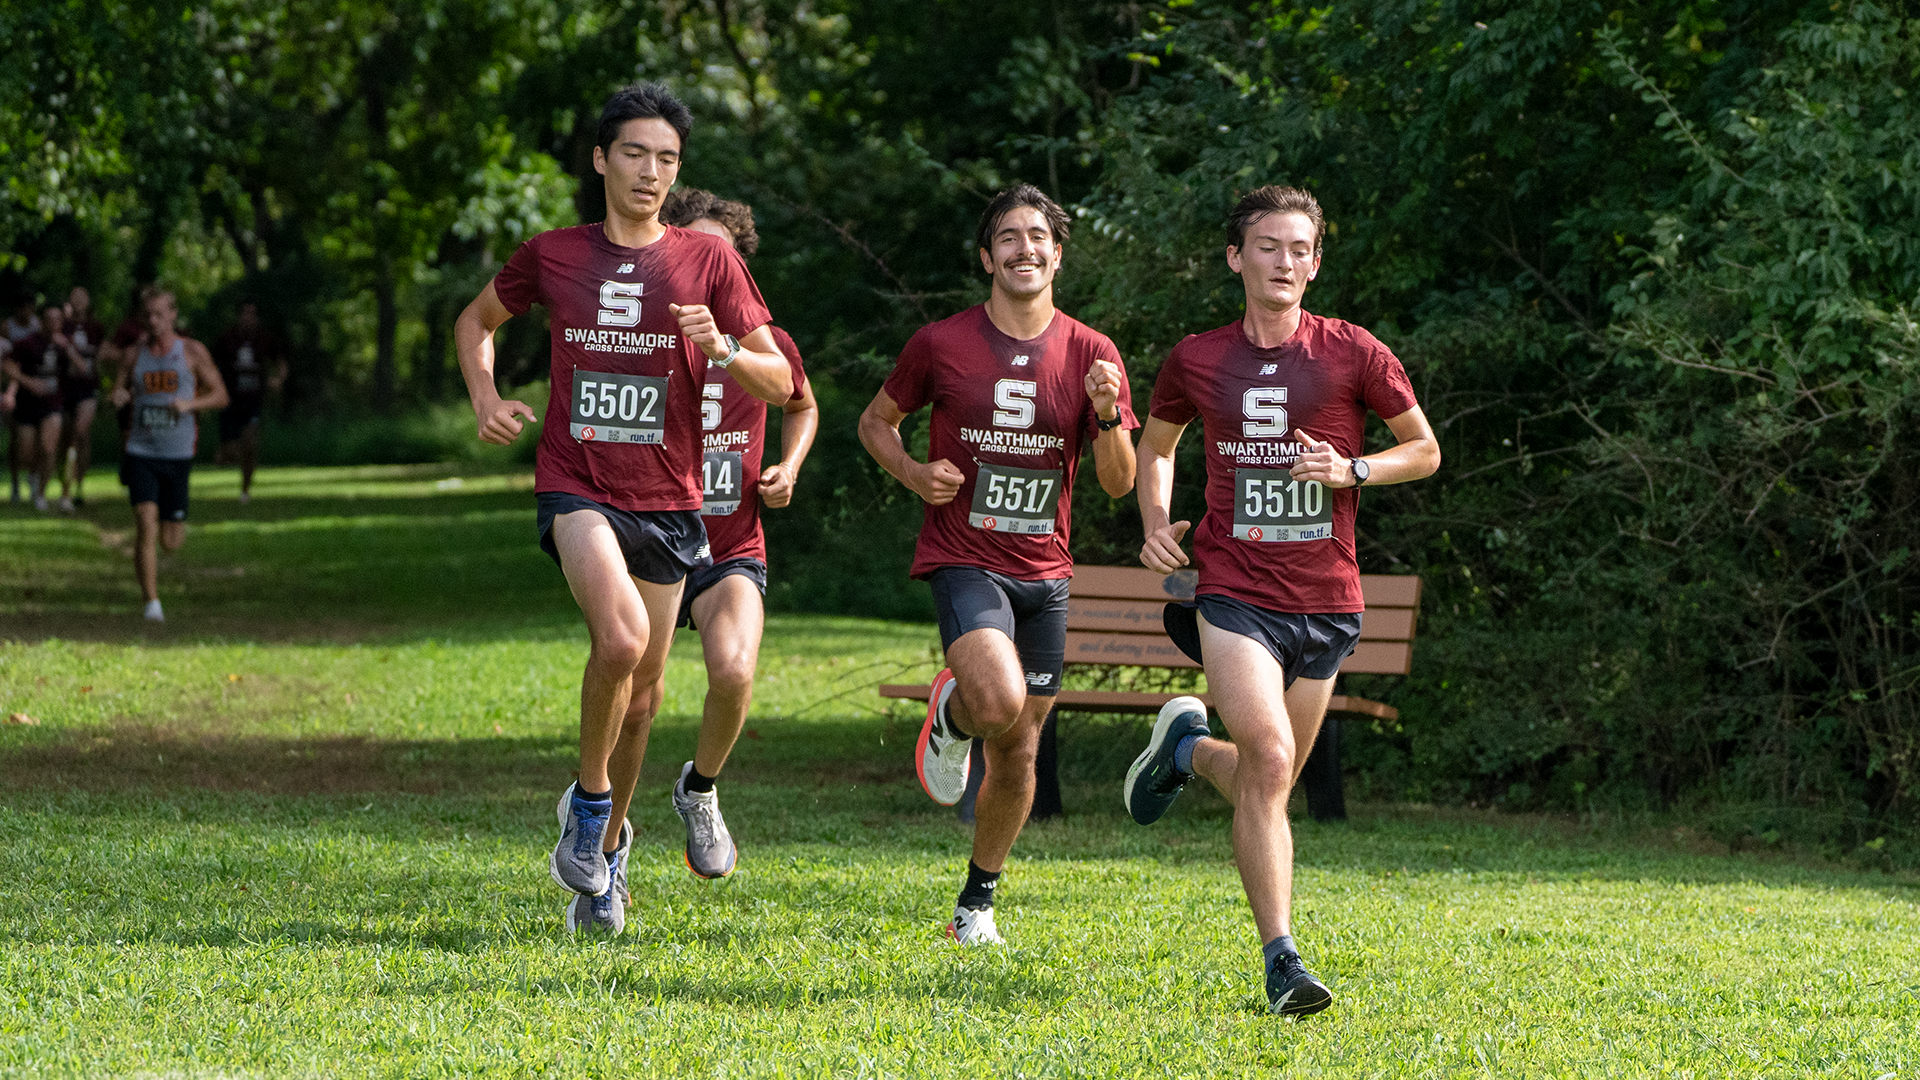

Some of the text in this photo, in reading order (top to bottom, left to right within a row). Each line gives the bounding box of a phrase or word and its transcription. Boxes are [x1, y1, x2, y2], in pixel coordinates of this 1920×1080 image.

[597, 280, 644, 327] S
[564, 328, 677, 349] SWARTHMORE
[584, 343, 654, 355] CROSS COUNTRY
[579, 381, 659, 422] 5502
[992, 378, 1037, 429] S
[1242, 387, 1289, 438] S
[582, 428, 593, 439] NT
[630, 433, 655, 442] run.tf
[960, 427, 1065, 450] SWARTHMORE
[979, 444, 1045, 456] CROSS COUNTRY
[1216, 441, 1327, 457] SWARTHMO
[1236, 456, 1261, 464] CROSS
[702, 461, 734, 495] 14
[985, 474, 1054, 513] 5517
[1245, 479, 1323, 518] 5510
[711, 504, 734, 514] run.tf
[984, 517, 994, 528] NT
[1027, 523, 1047, 532] run.tf
[1249, 528, 1261, 540] NT
[1300, 527, 1324, 539] run.tf
